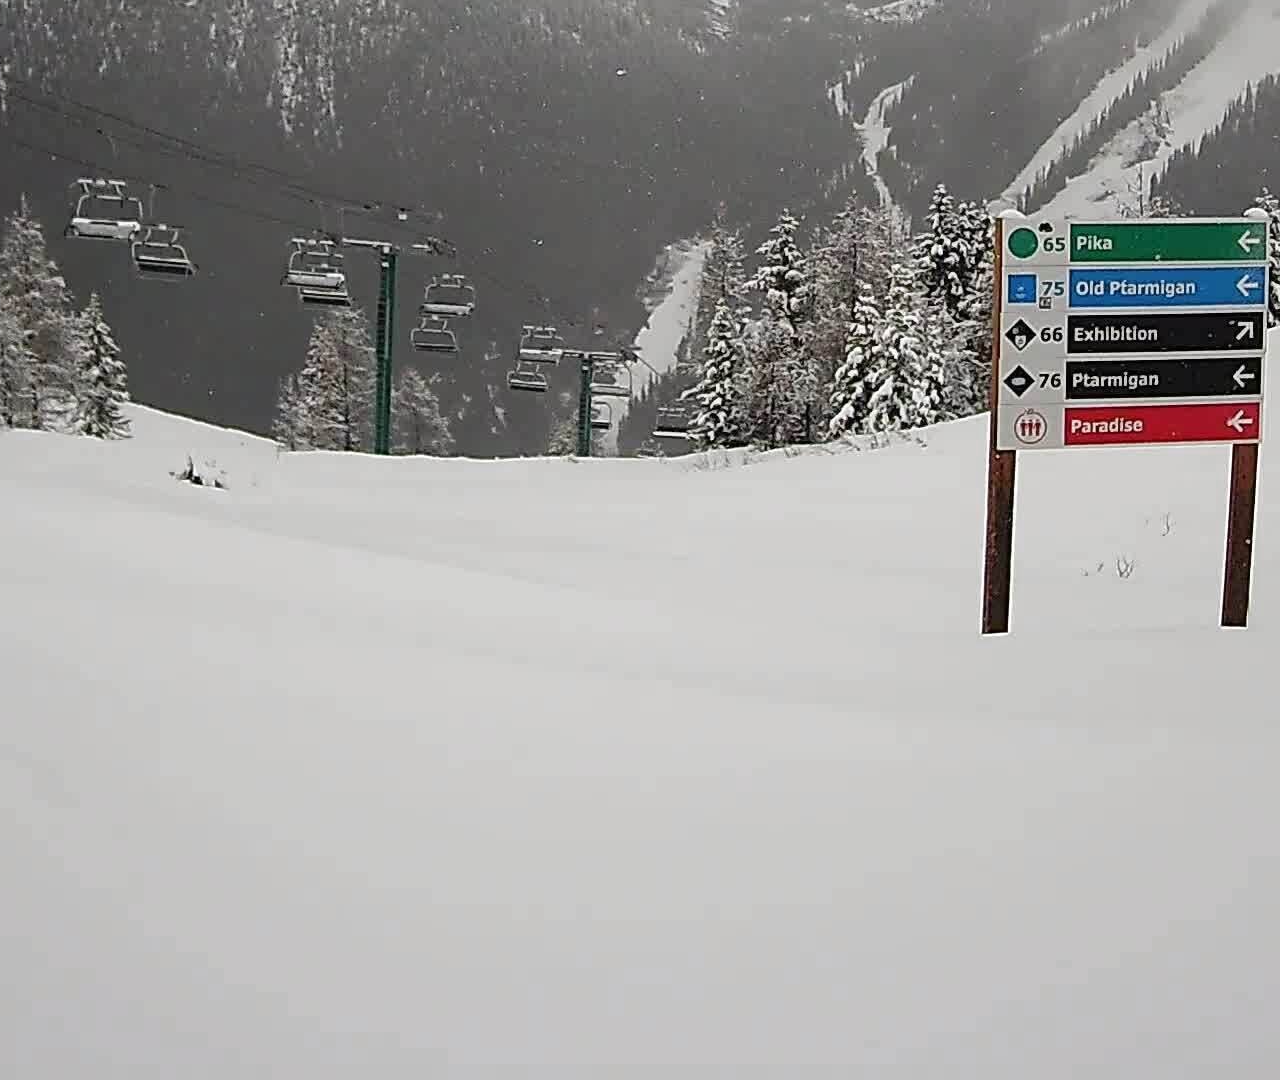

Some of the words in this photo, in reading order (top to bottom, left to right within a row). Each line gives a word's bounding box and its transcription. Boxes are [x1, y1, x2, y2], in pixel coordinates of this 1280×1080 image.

[1042, 236, 1066, 253] 65
[1076, 235, 1113, 251] Pika
[1041, 281, 1065, 297] 75
[1075, 280, 1105, 296] Old
[1109, 280, 1196, 298] Ptarmigan
[1040, 327, 1064, 344] 66
[1073, 325, 1158, 342] Exhibition
[1038, 373, 1062, 389] 76
[1072, 372, 1159, 389] Ptarmigan
[1070, 418, 1144, 434] Paradise
